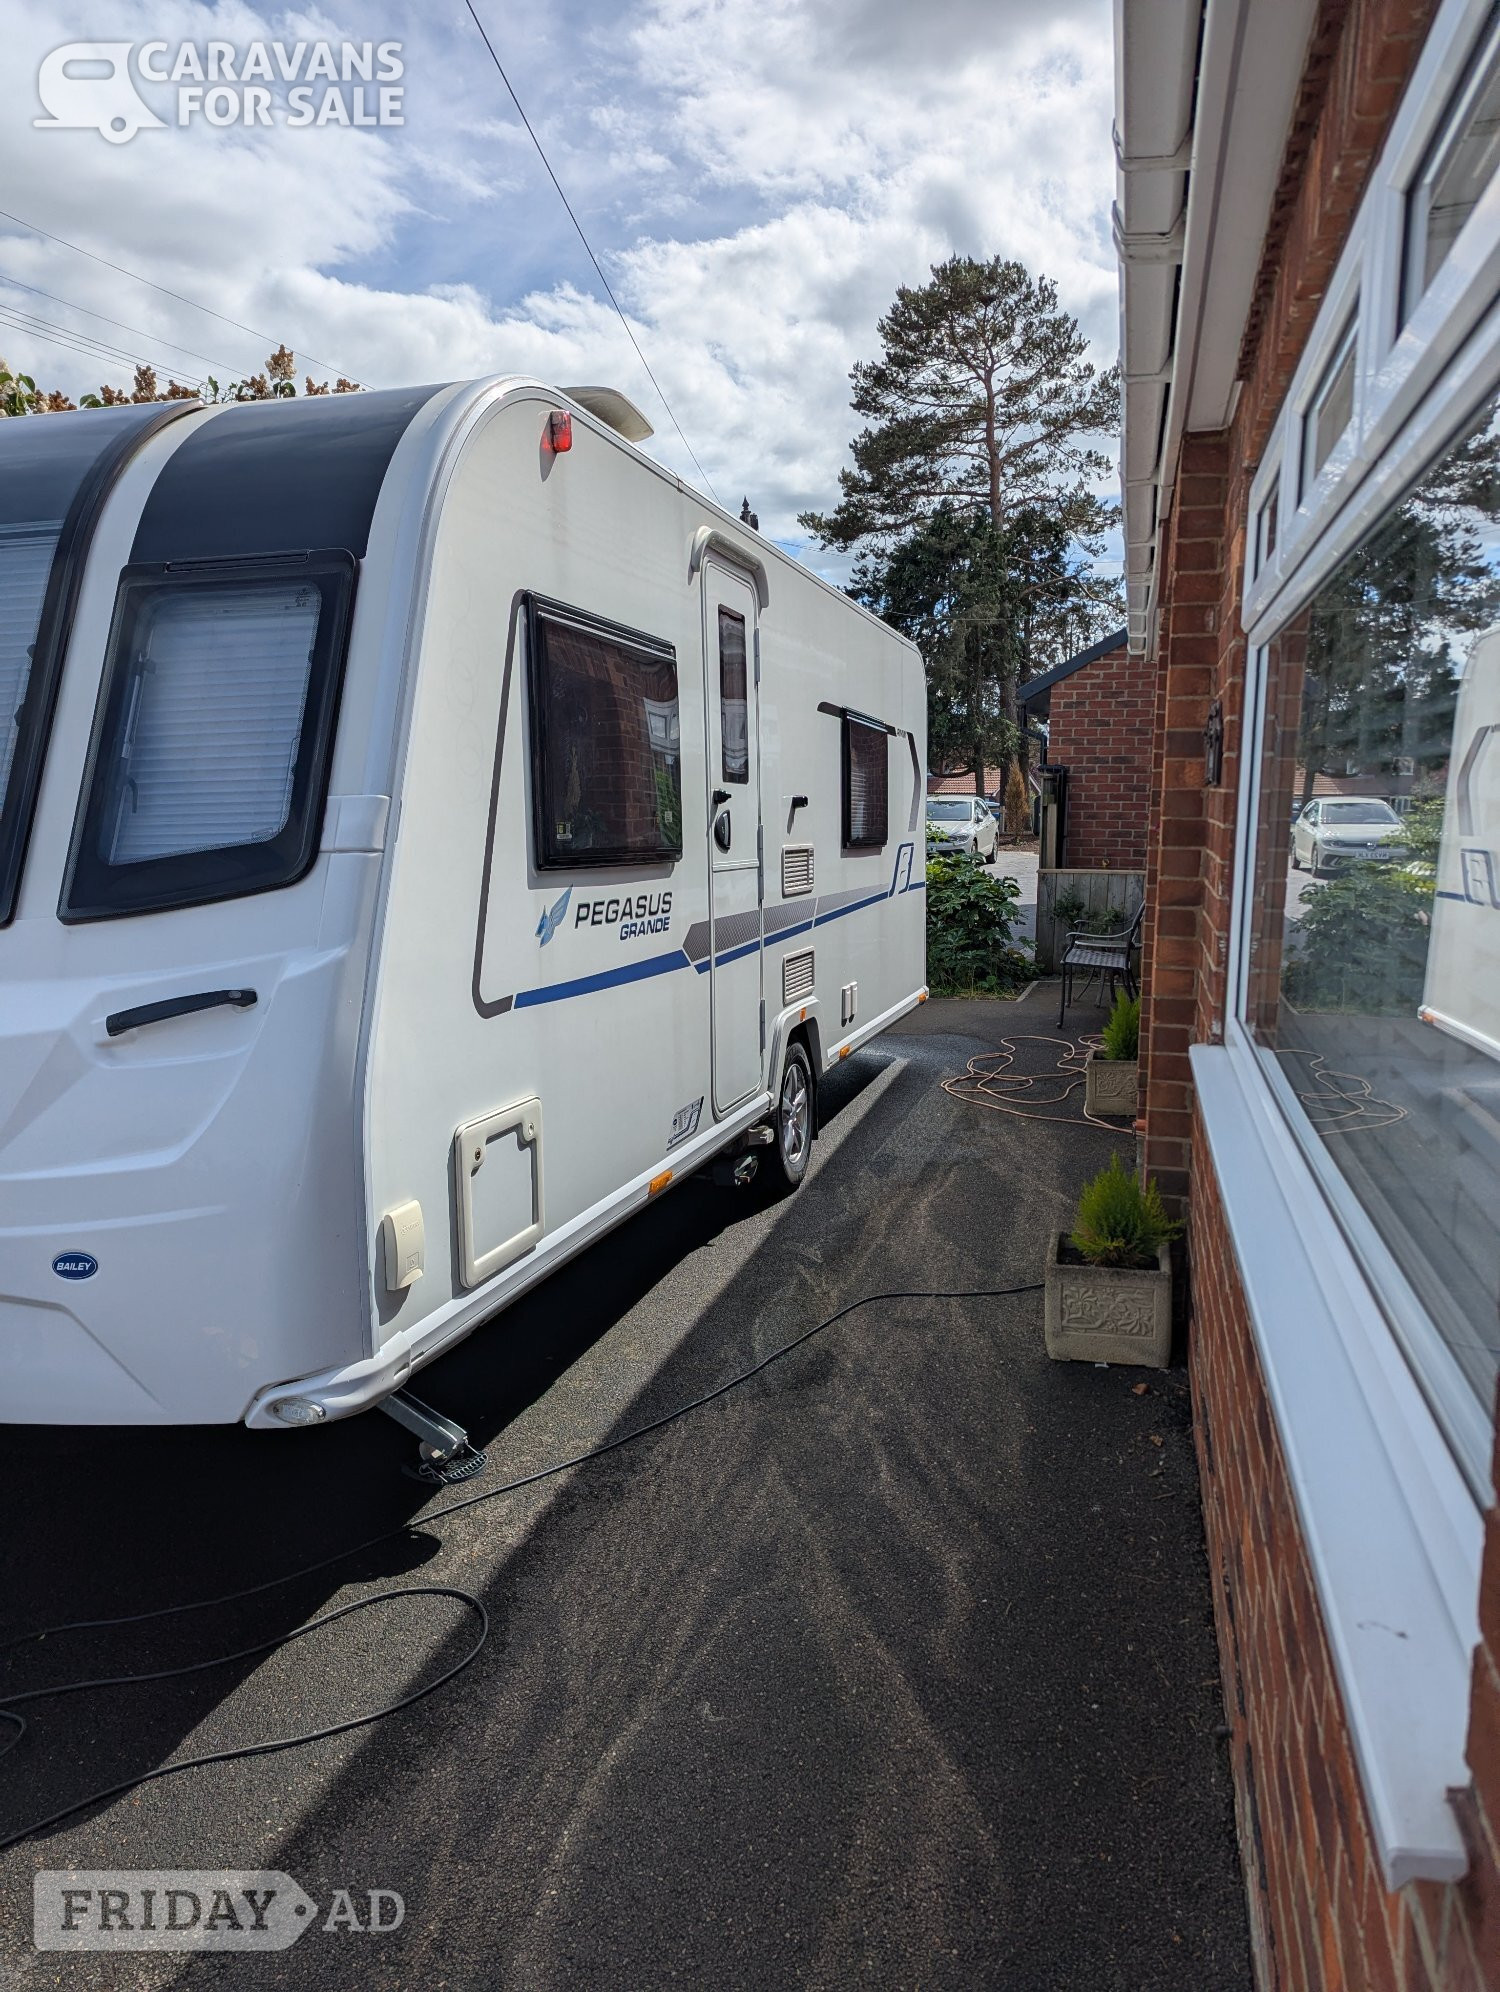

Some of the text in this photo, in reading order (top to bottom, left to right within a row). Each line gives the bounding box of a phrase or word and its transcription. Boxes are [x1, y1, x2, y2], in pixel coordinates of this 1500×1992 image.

[574, 891, 673, 929] PEGASUS
[619, 916, 671, 941] GRANDE
[56, 1262, 92, 1271] BAILEY
